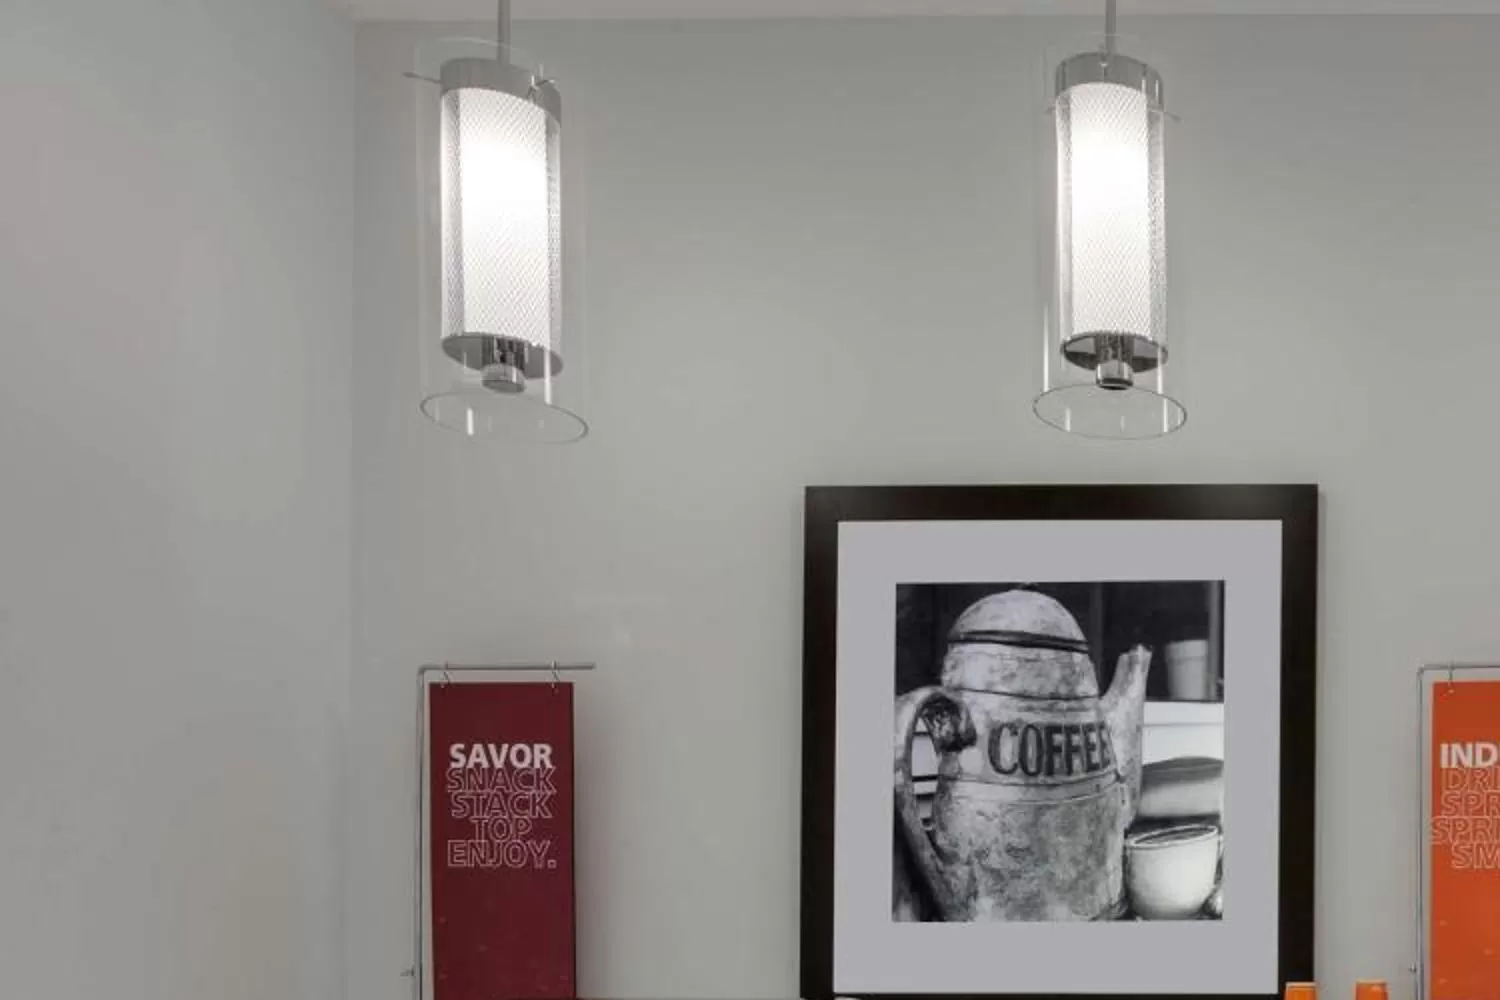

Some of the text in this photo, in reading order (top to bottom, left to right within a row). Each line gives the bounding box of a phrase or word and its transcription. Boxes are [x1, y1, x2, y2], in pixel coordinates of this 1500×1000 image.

[448, 743, 553, 768] SAVOR
[446, 767, 557, 792] SNACK
[451, 792, 552, 818] STACK
[471, 817, 533, 842] TOP
[447, 840, 557, 868] ENJOY.
